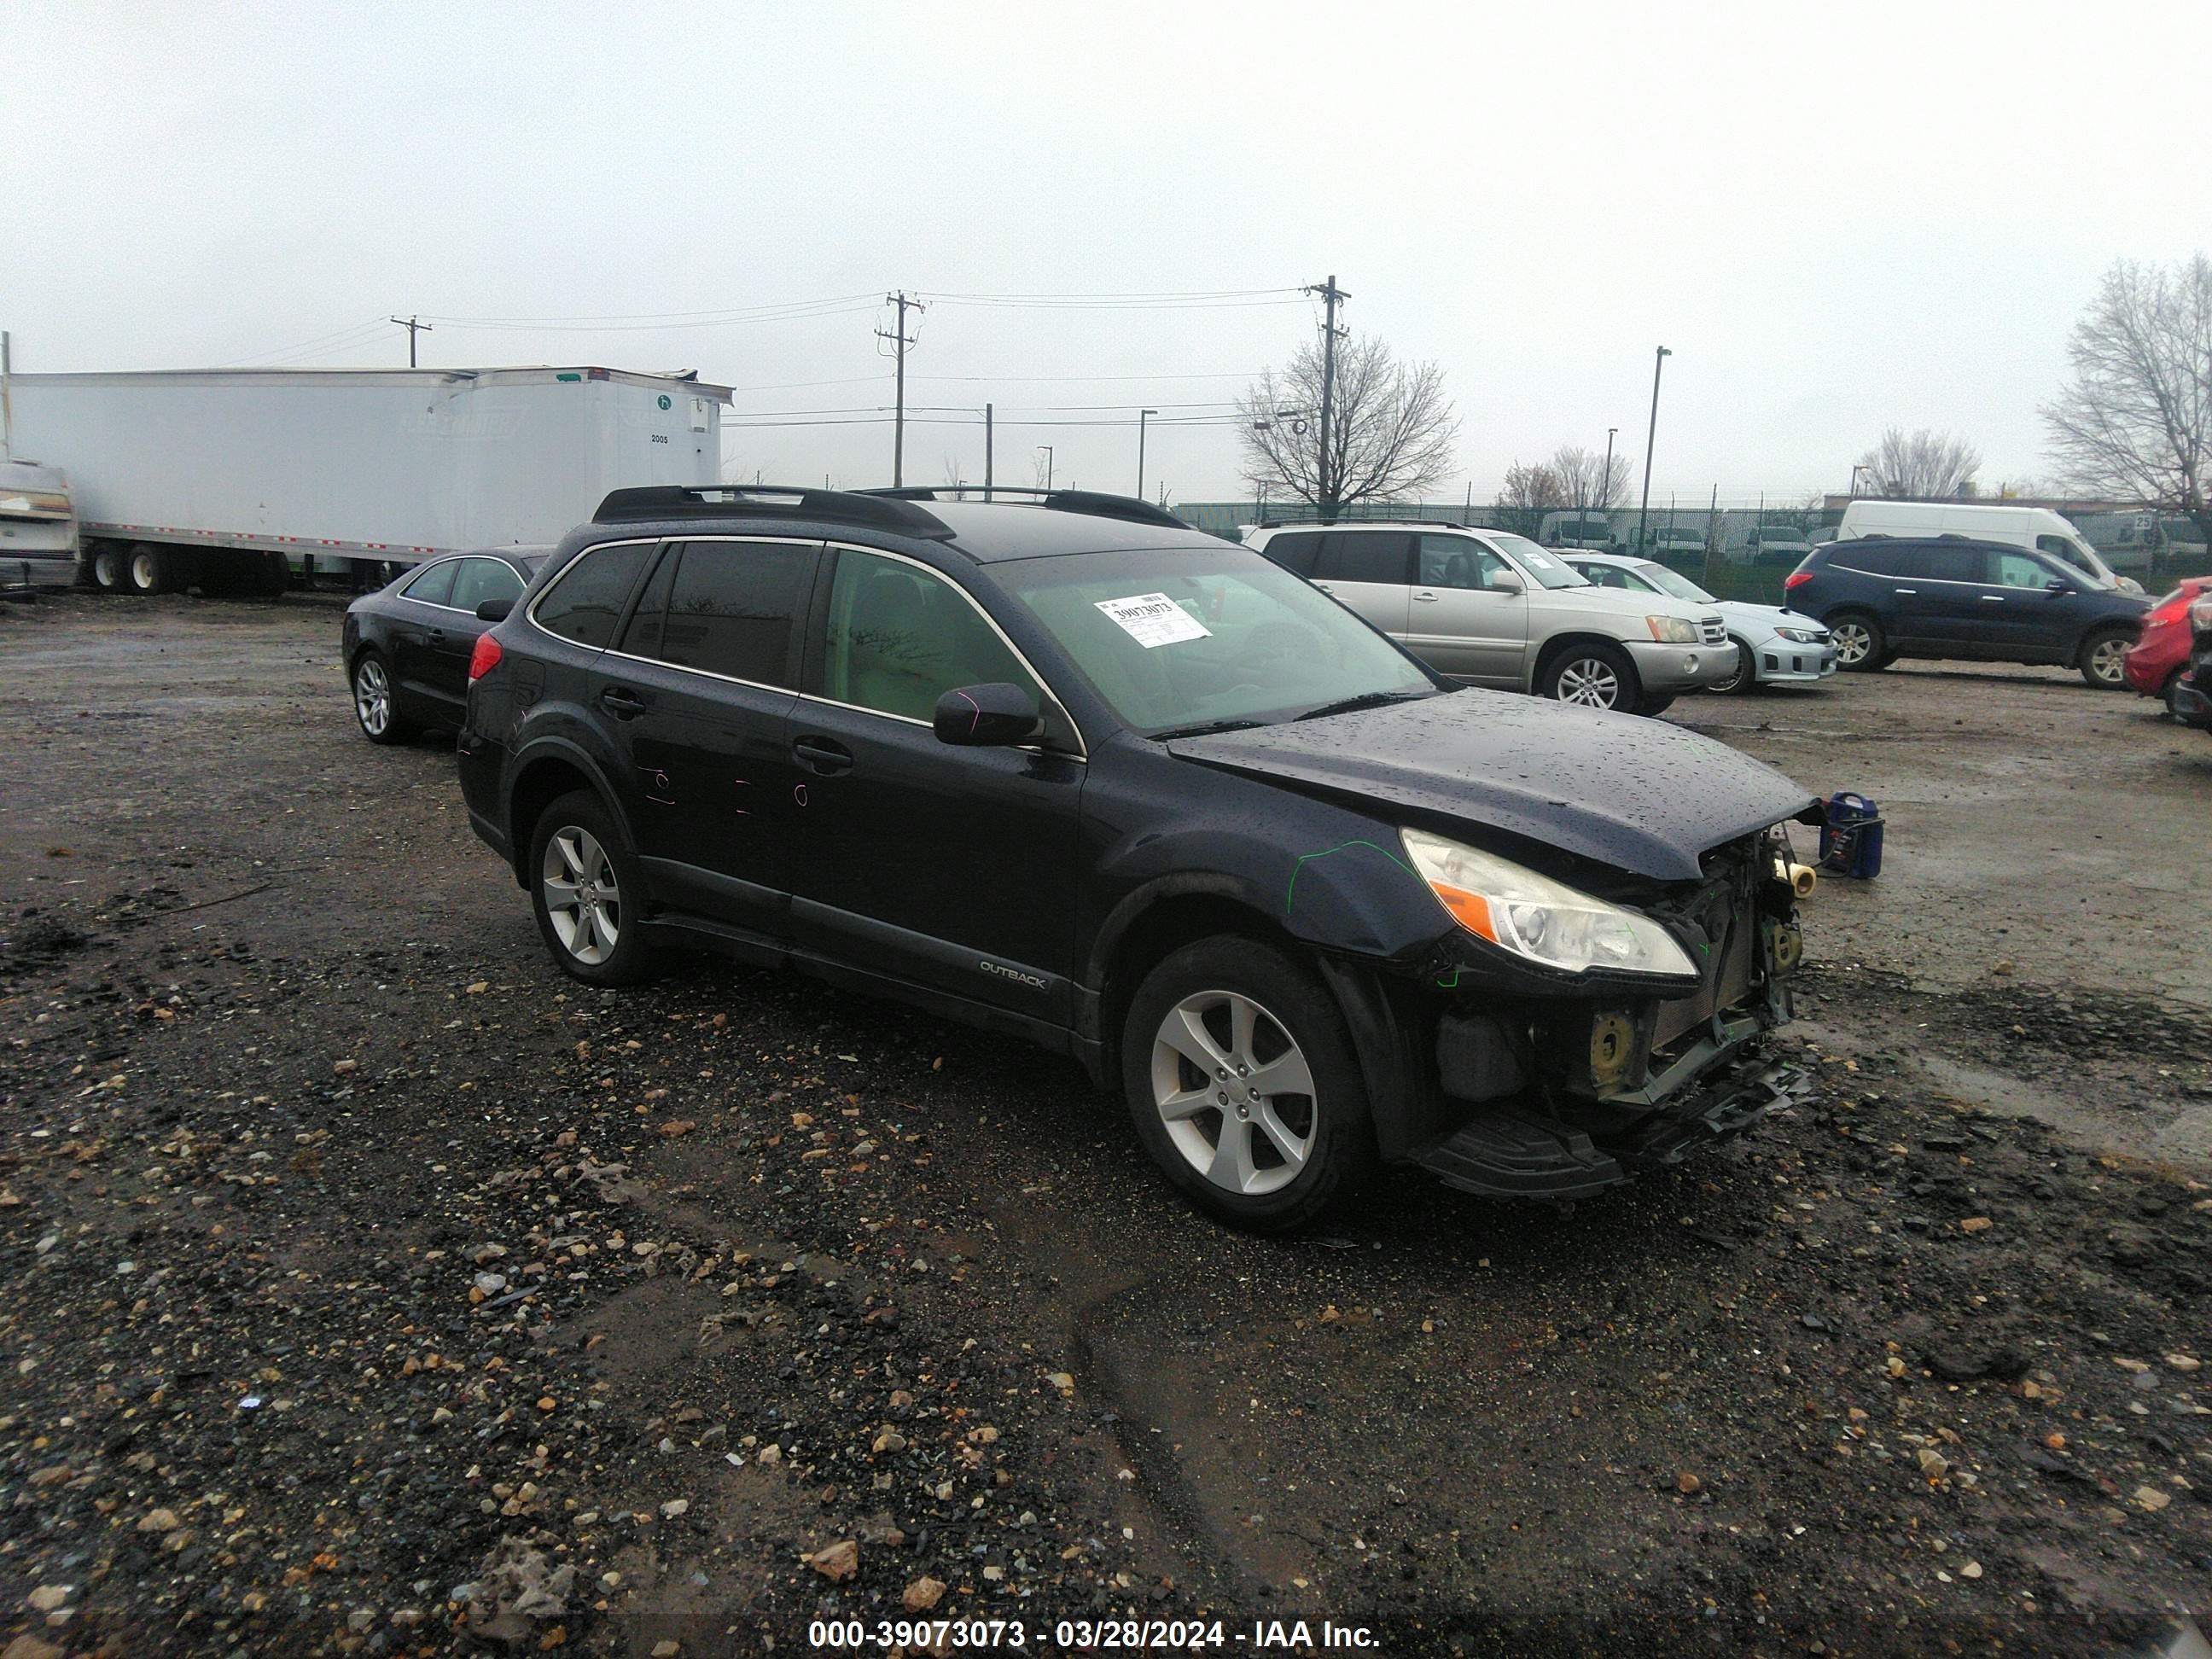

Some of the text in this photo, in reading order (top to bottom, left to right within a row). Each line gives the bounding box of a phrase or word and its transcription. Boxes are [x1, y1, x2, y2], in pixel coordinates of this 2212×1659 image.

[651, 434, 668, 445] 2005
[2136, 516, 2151, 527] 25
[1115, 602, 1173, 620] 39073073
[980, 961, 1045, 989] OUTBACK
